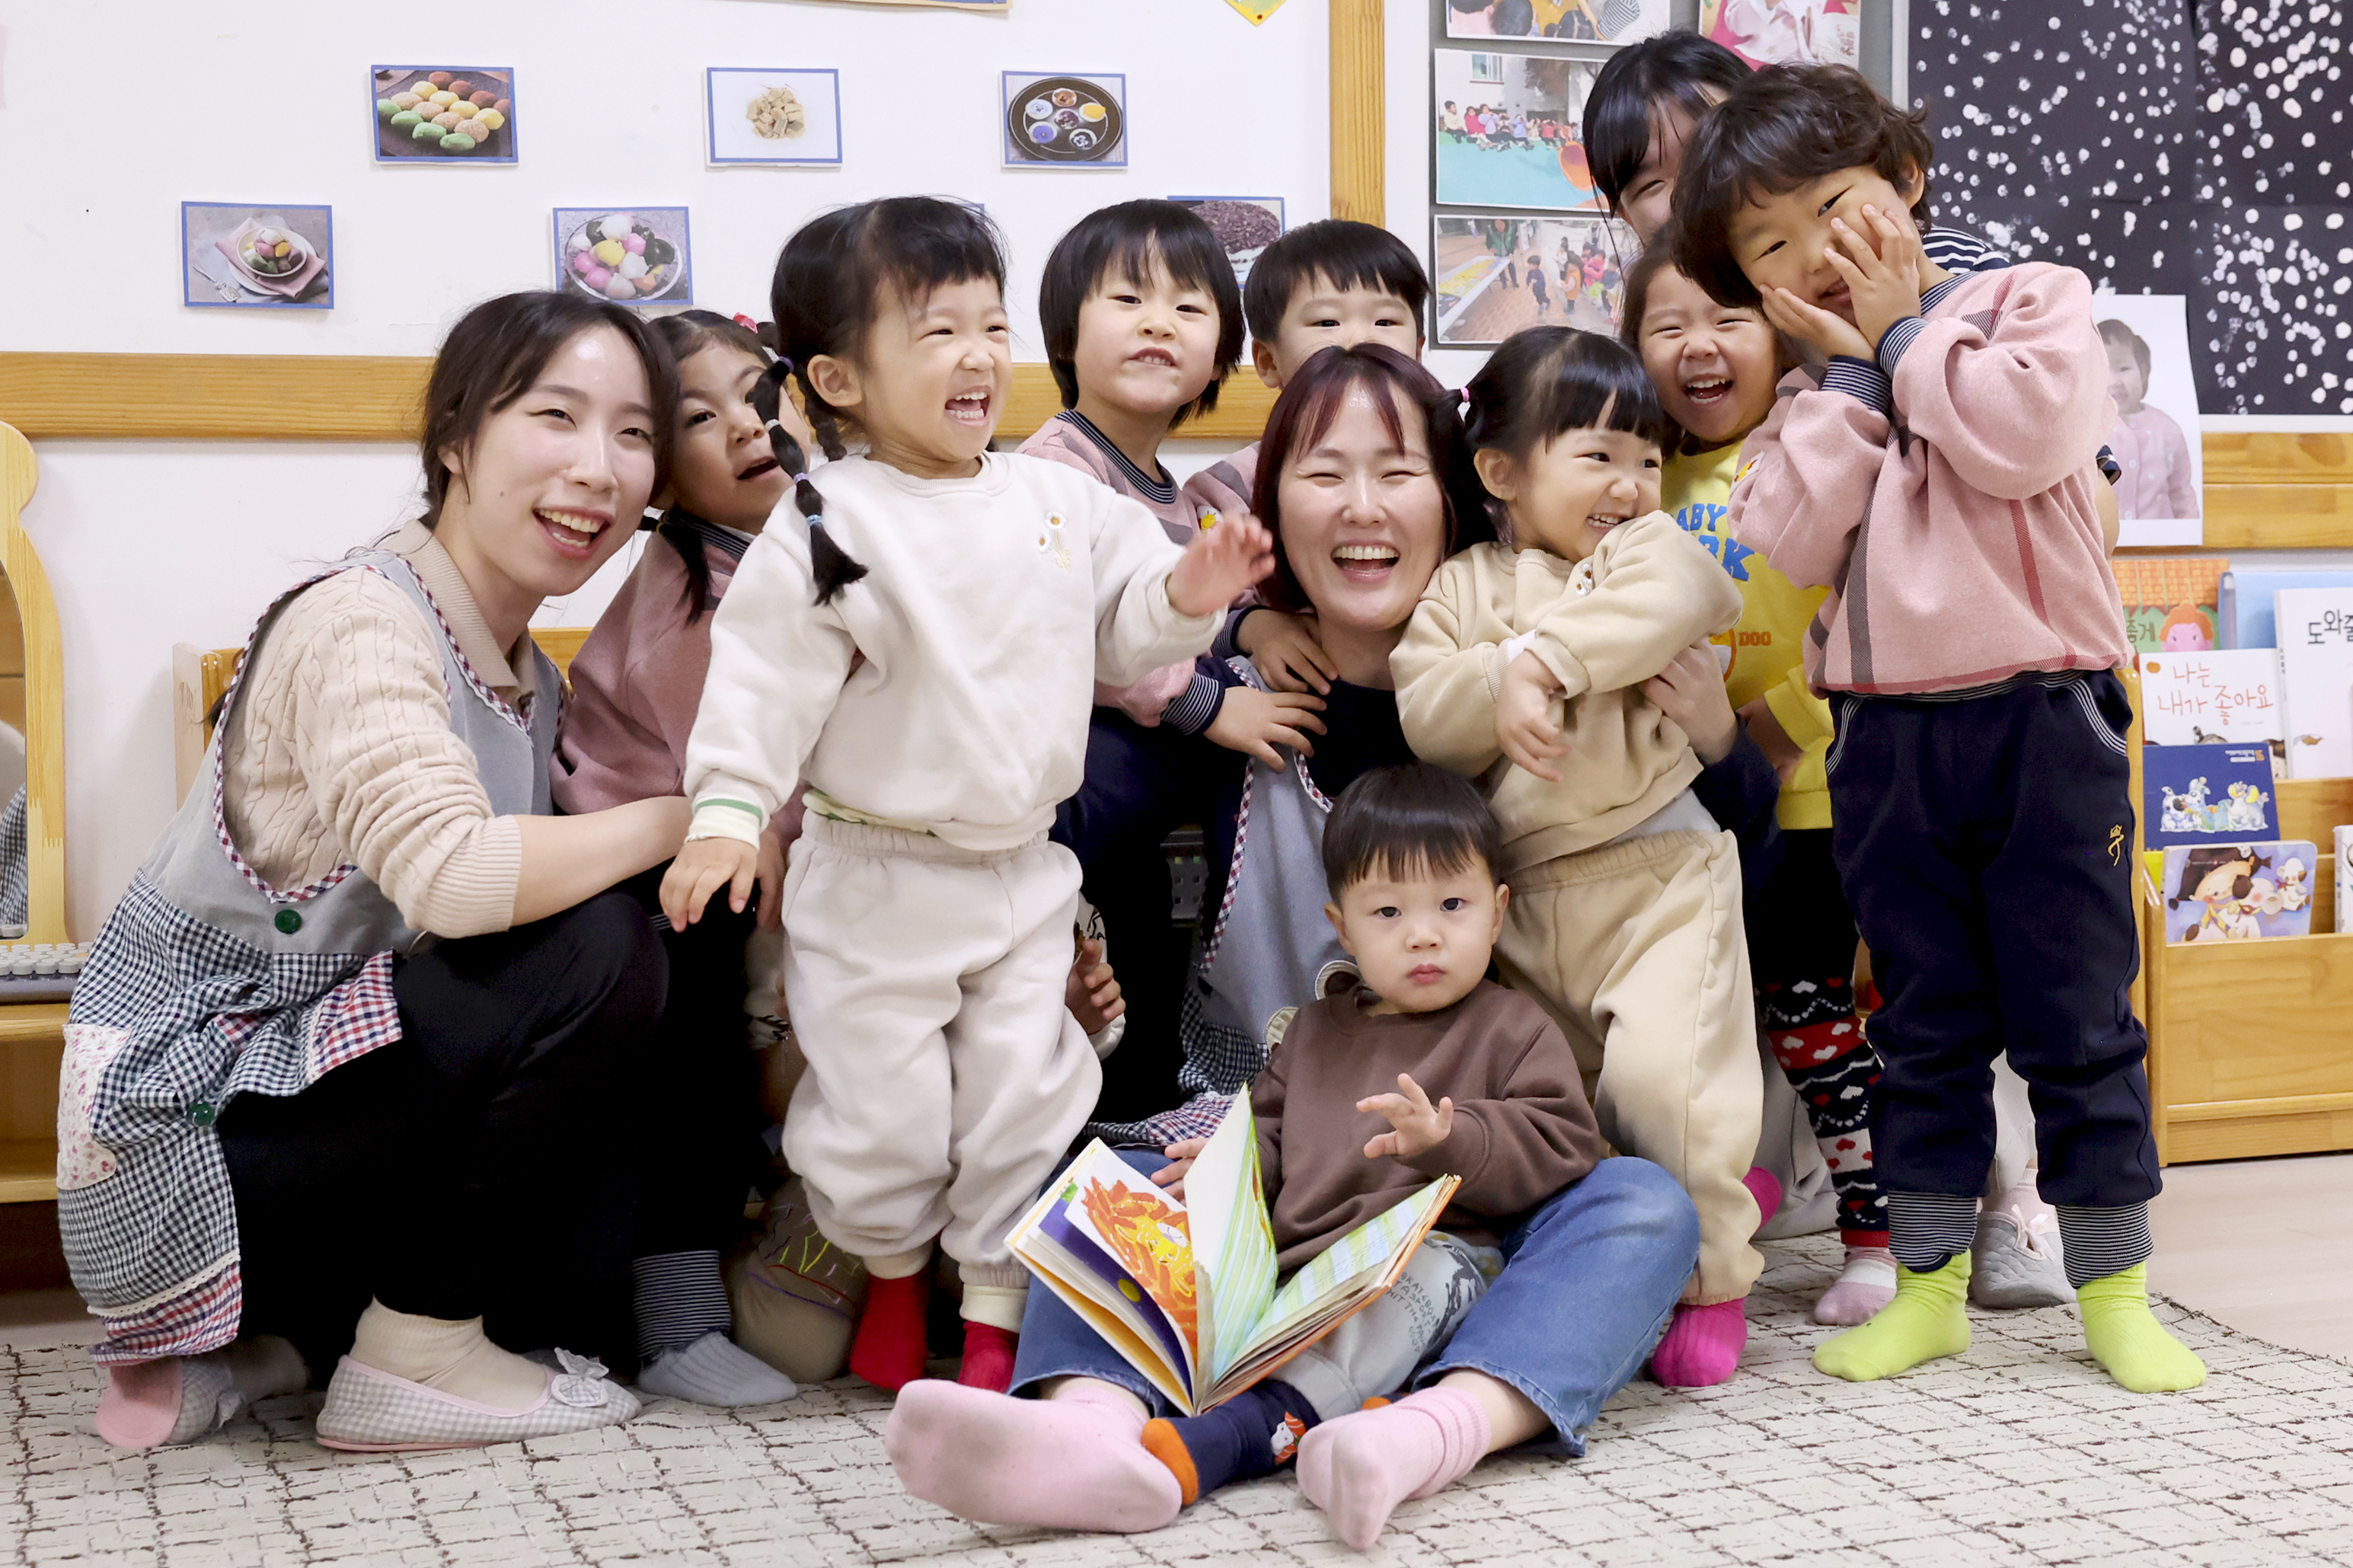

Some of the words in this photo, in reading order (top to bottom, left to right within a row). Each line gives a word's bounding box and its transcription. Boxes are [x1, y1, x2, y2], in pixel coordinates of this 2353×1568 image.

[1671, 503, 1727, 532] ABY
[1698, 535, 1754, 582] RK
[1738, 631, 1772, 647] DOO
[2173, 662, 2210, 688] 나는
[2157, 689, 2208, 716] 내가
[2214, 684, 2274, 726] 좋아요
